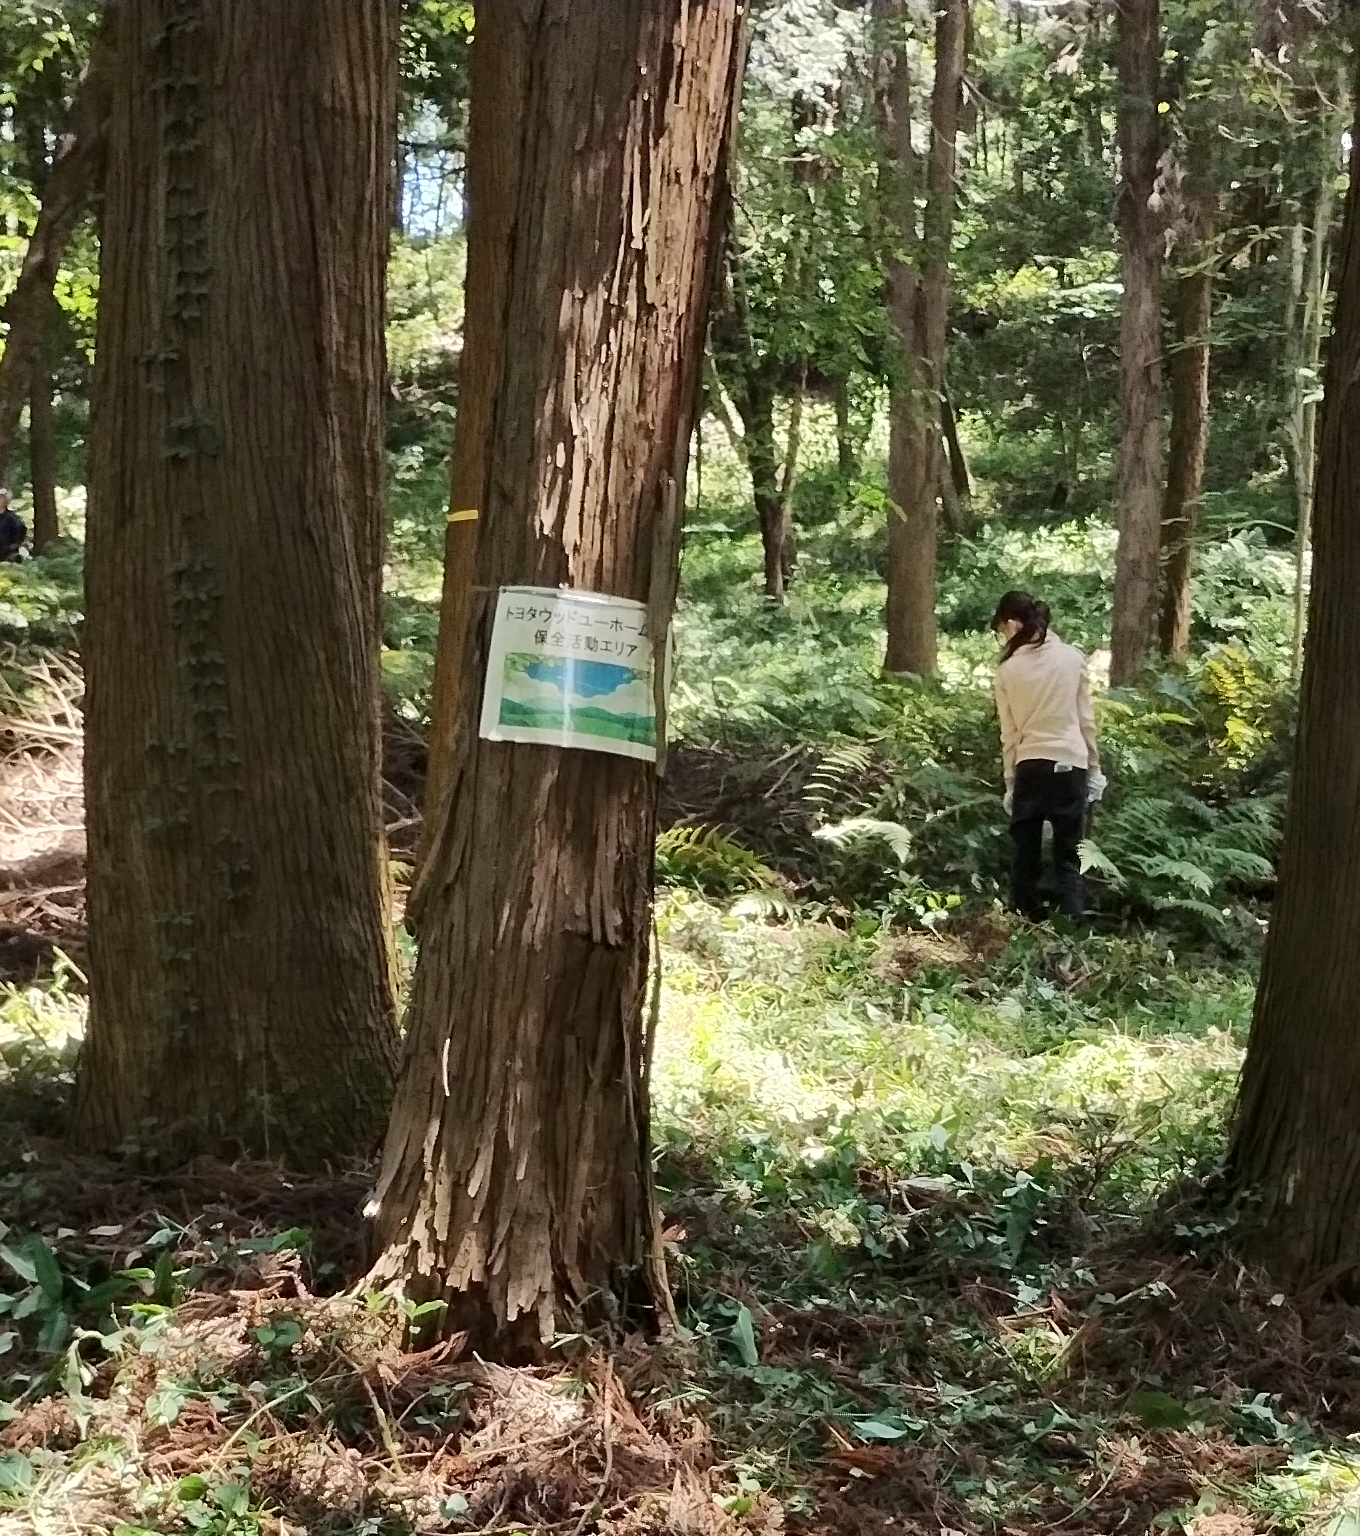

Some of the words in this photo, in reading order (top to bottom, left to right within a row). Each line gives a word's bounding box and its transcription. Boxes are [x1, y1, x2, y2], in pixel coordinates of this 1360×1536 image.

[534, 629, 638, 657] 保全活動エリア
